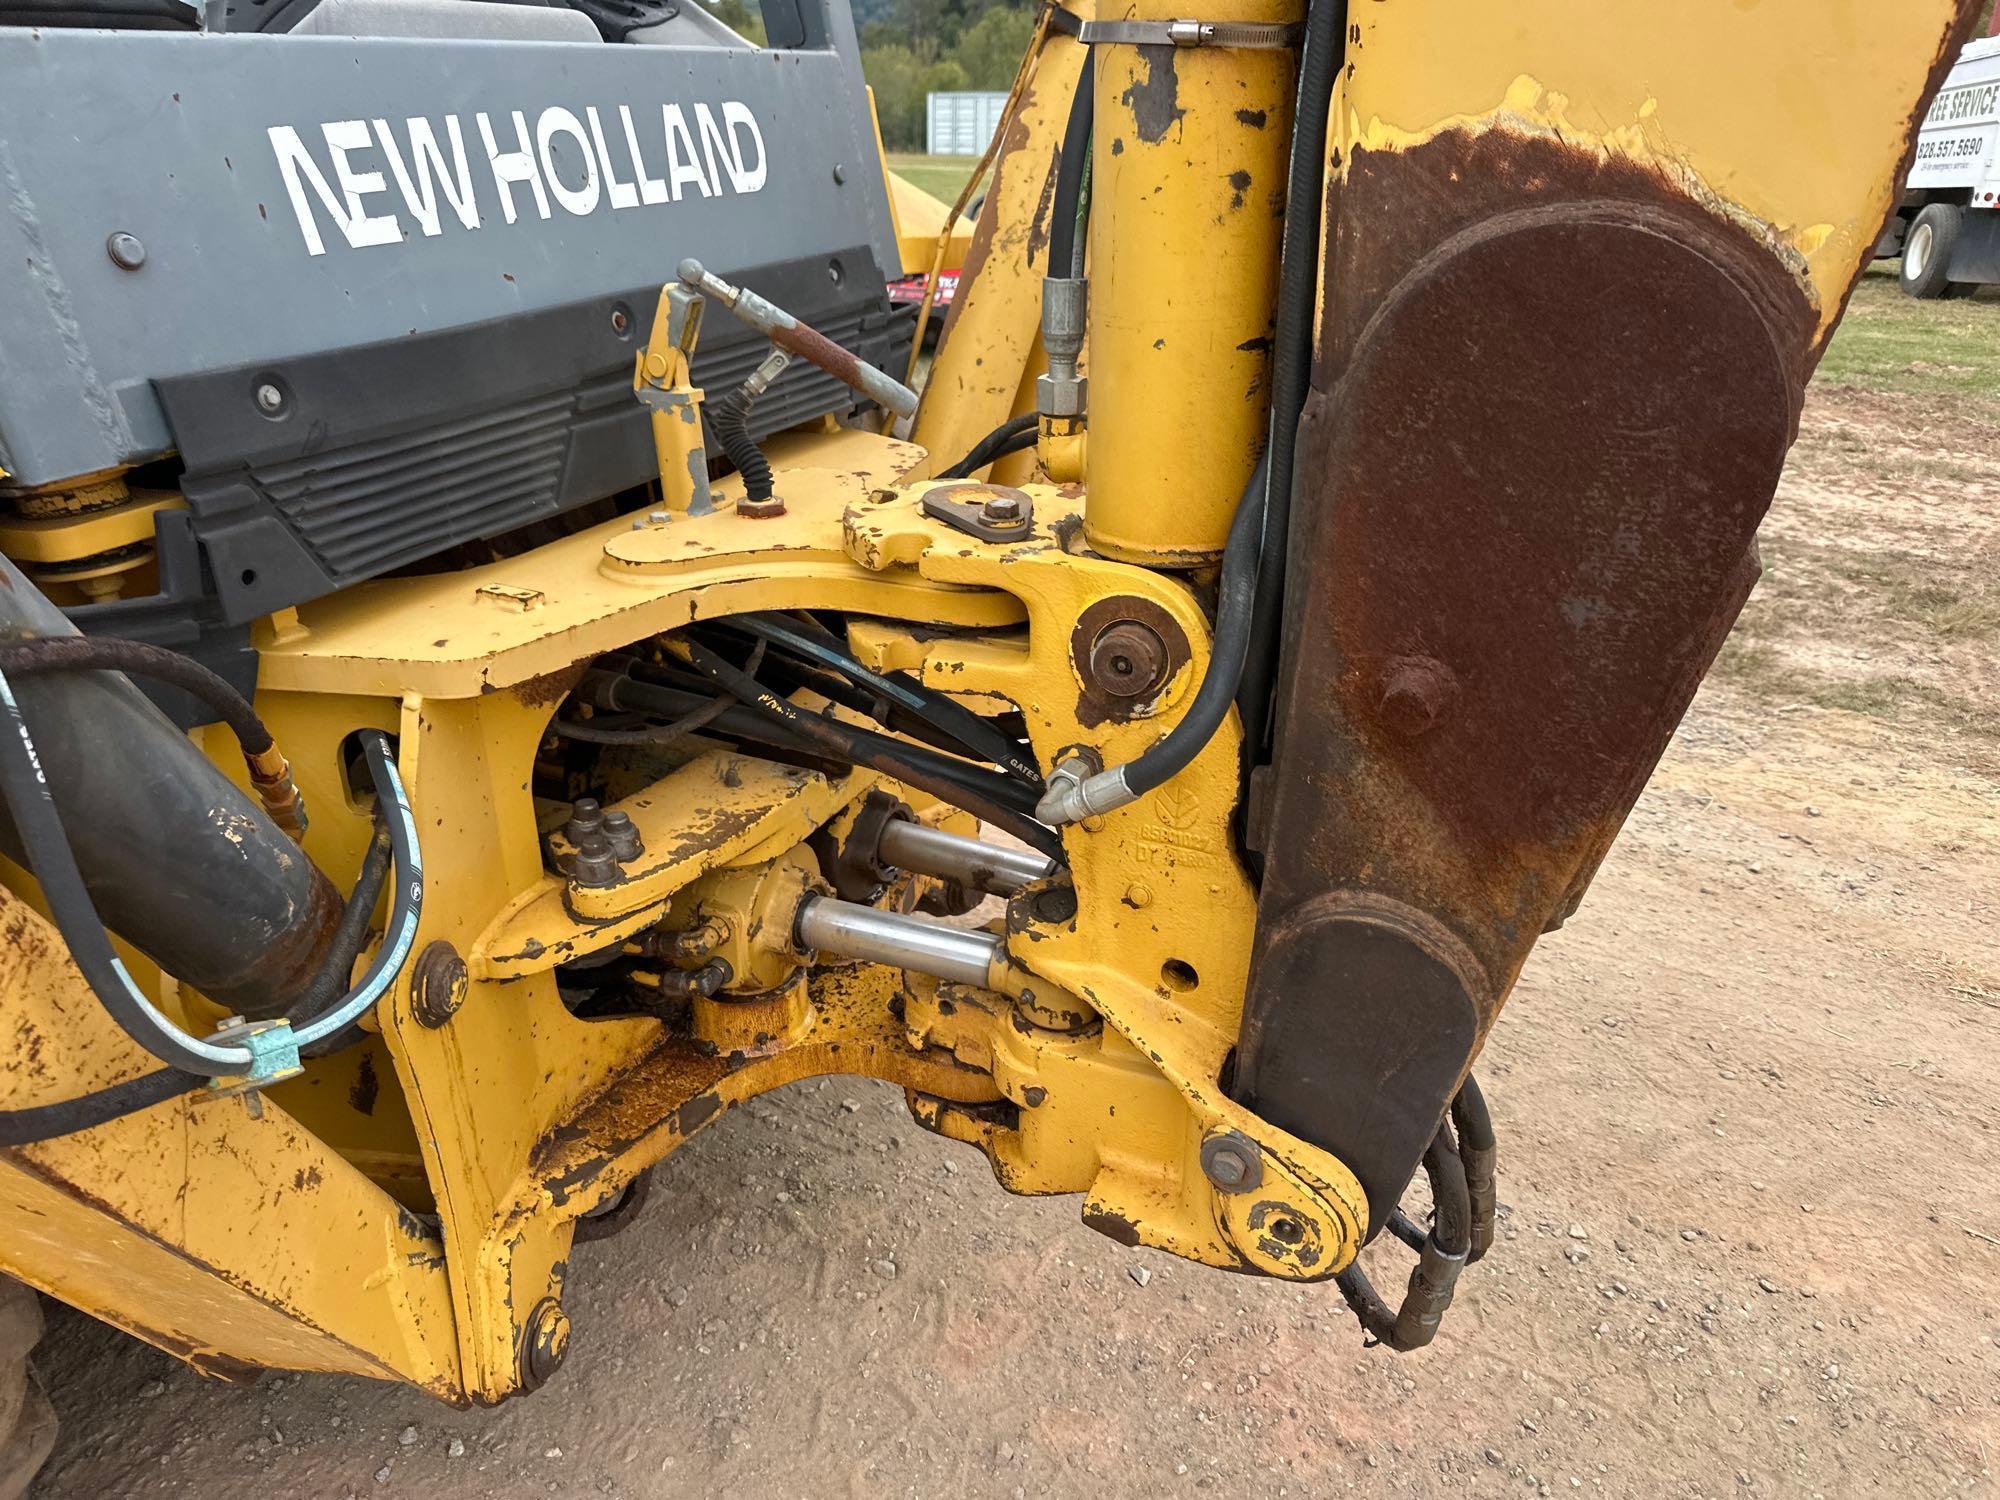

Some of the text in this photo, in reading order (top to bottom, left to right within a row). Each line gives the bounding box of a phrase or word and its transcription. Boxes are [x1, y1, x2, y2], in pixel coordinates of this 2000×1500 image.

[1928, 85, 2000, 122] REE SERVICE
[1918, 137, 1983, 160] 828.557.5690
[267, 101, 768, 257] NEW HOLLAND
[1010, 758, 1040, 782] GATES
